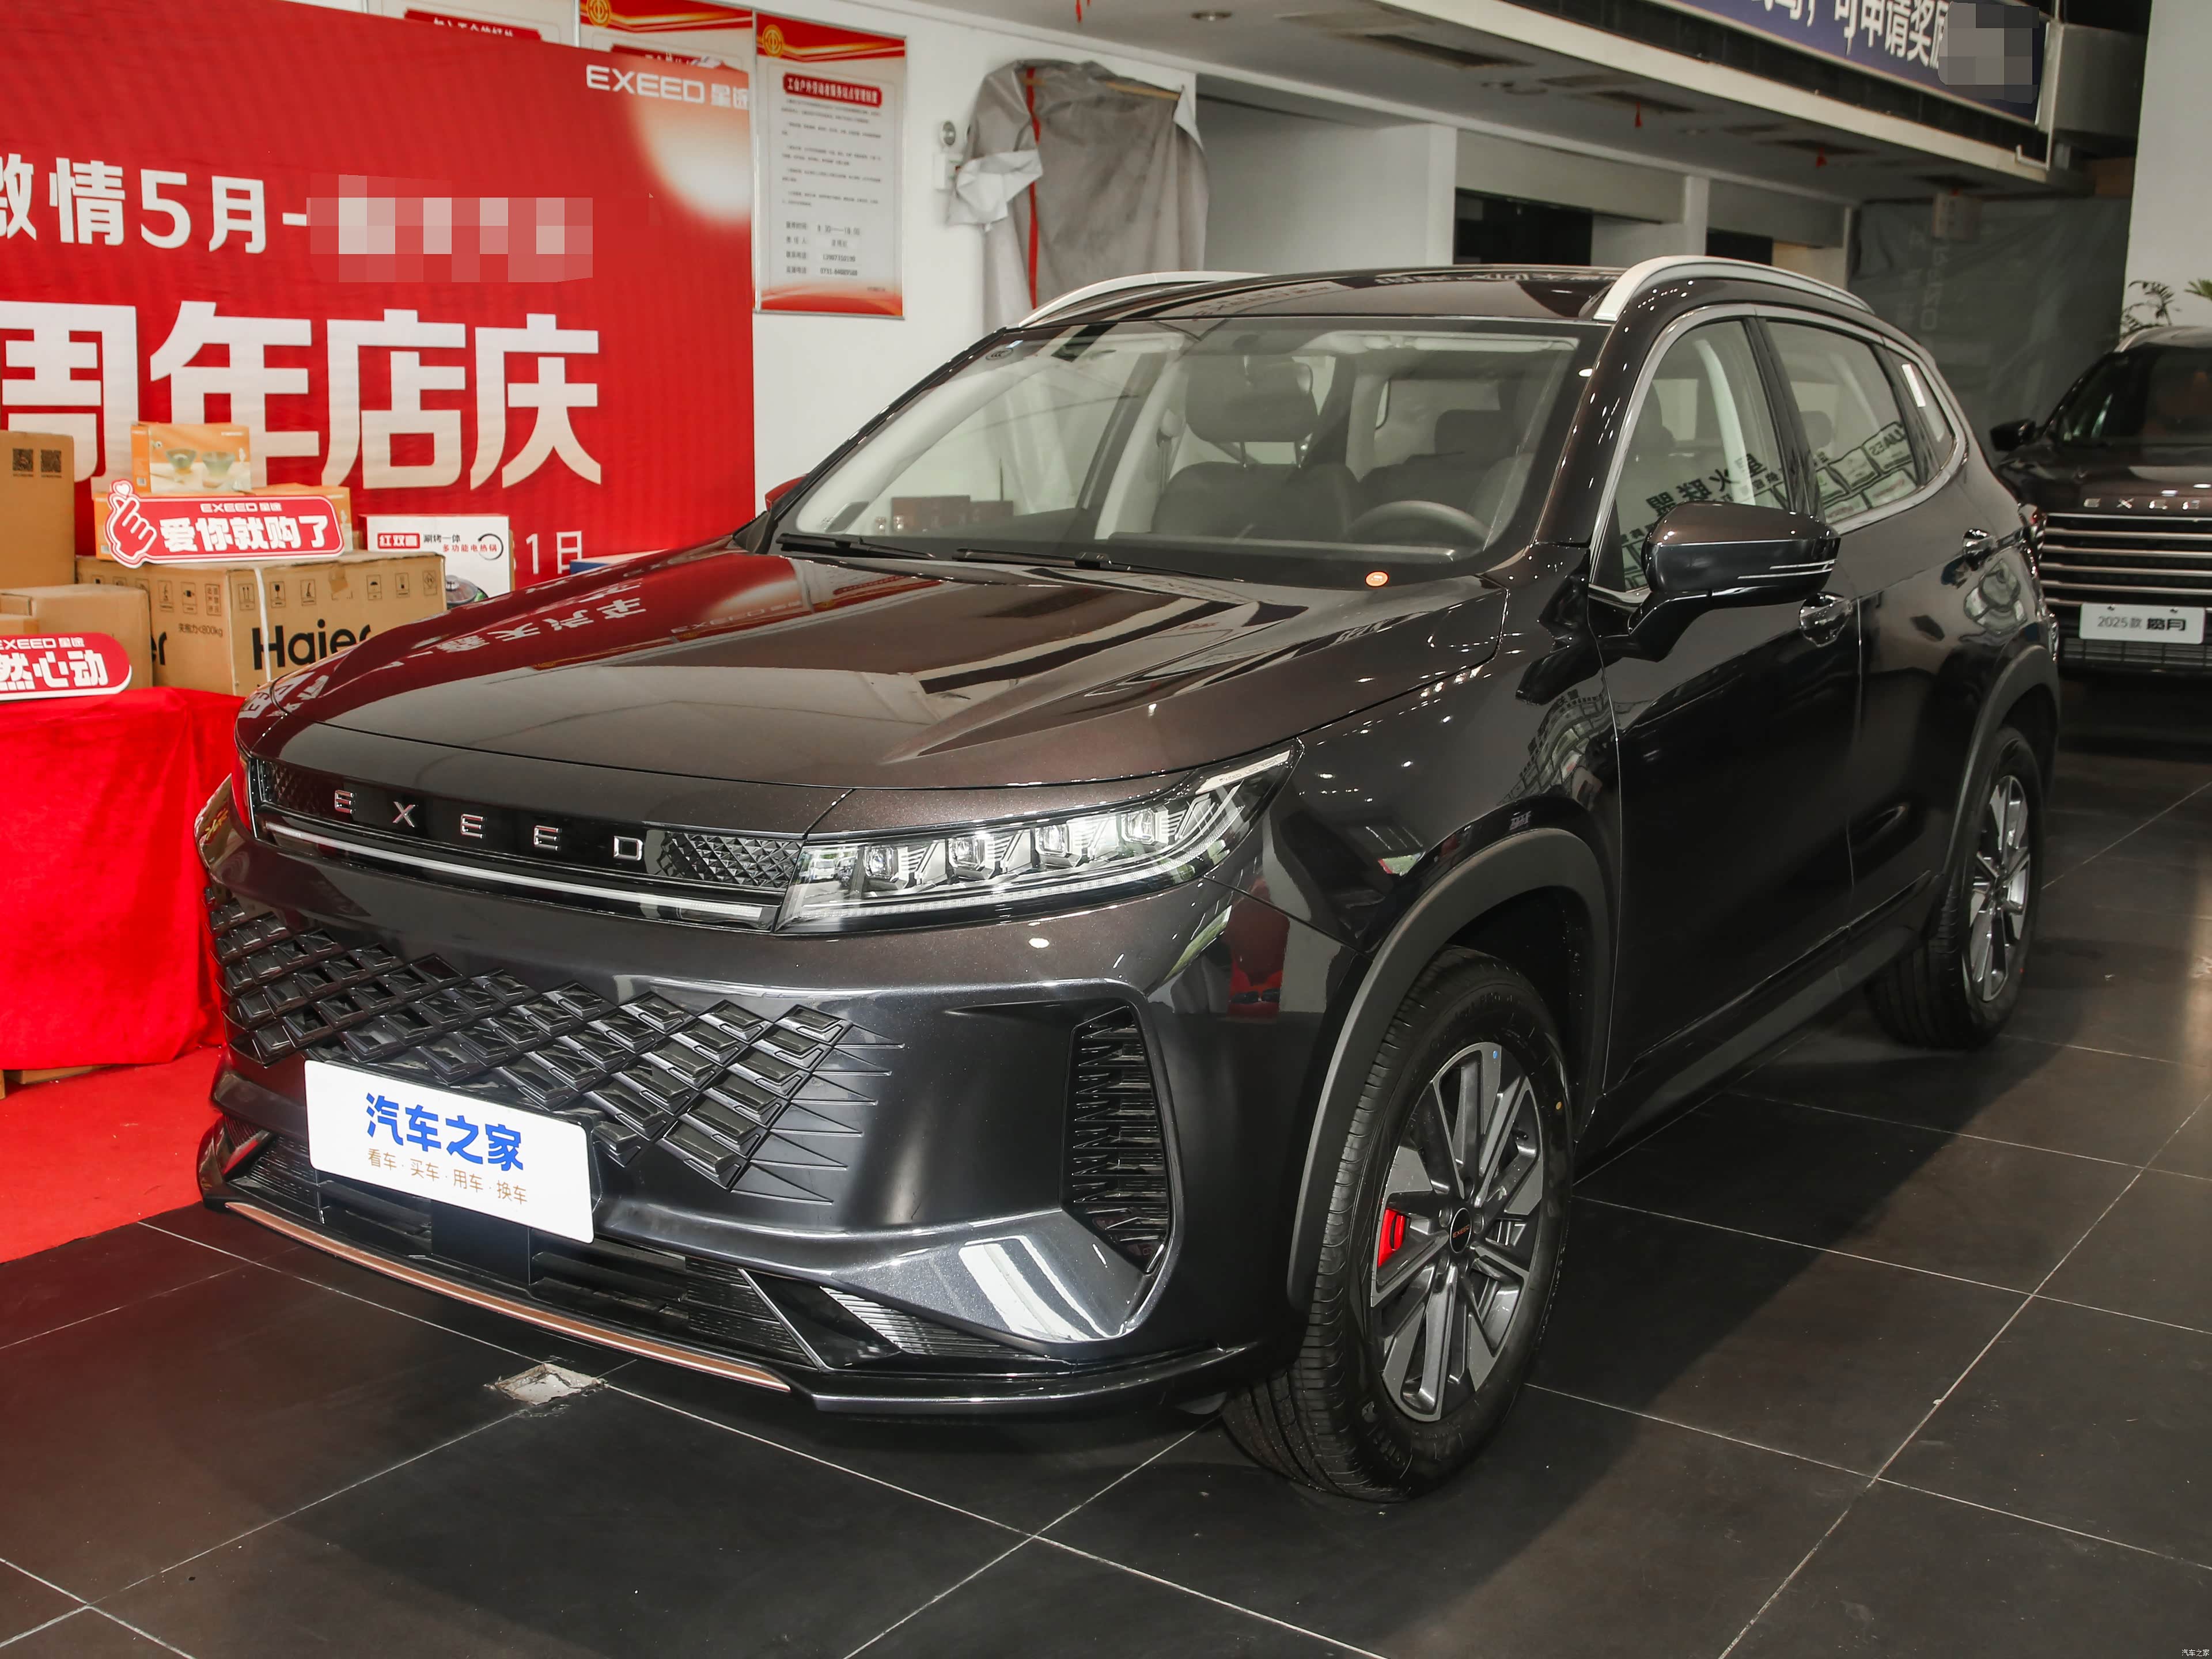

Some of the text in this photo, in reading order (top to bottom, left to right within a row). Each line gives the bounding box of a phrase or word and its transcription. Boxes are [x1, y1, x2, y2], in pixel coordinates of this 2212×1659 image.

[586, 64, 704, 104] EXEED
[0, 300, 602, 491] 周年店庆
[200, 503, 258, 513] EXEED
[160, 515, 328, 552] 爱你就购了
[379, 535, 417, 547] 红双喜
[442, 544, 498, 552] 多功能电热锅
[0, 638, 56, 650] XEED
[0, 650, 108, 691] 然心动
[335, 790, 643, 861] EXEED
[366, 1093, 524, 1171] 汽车之家
